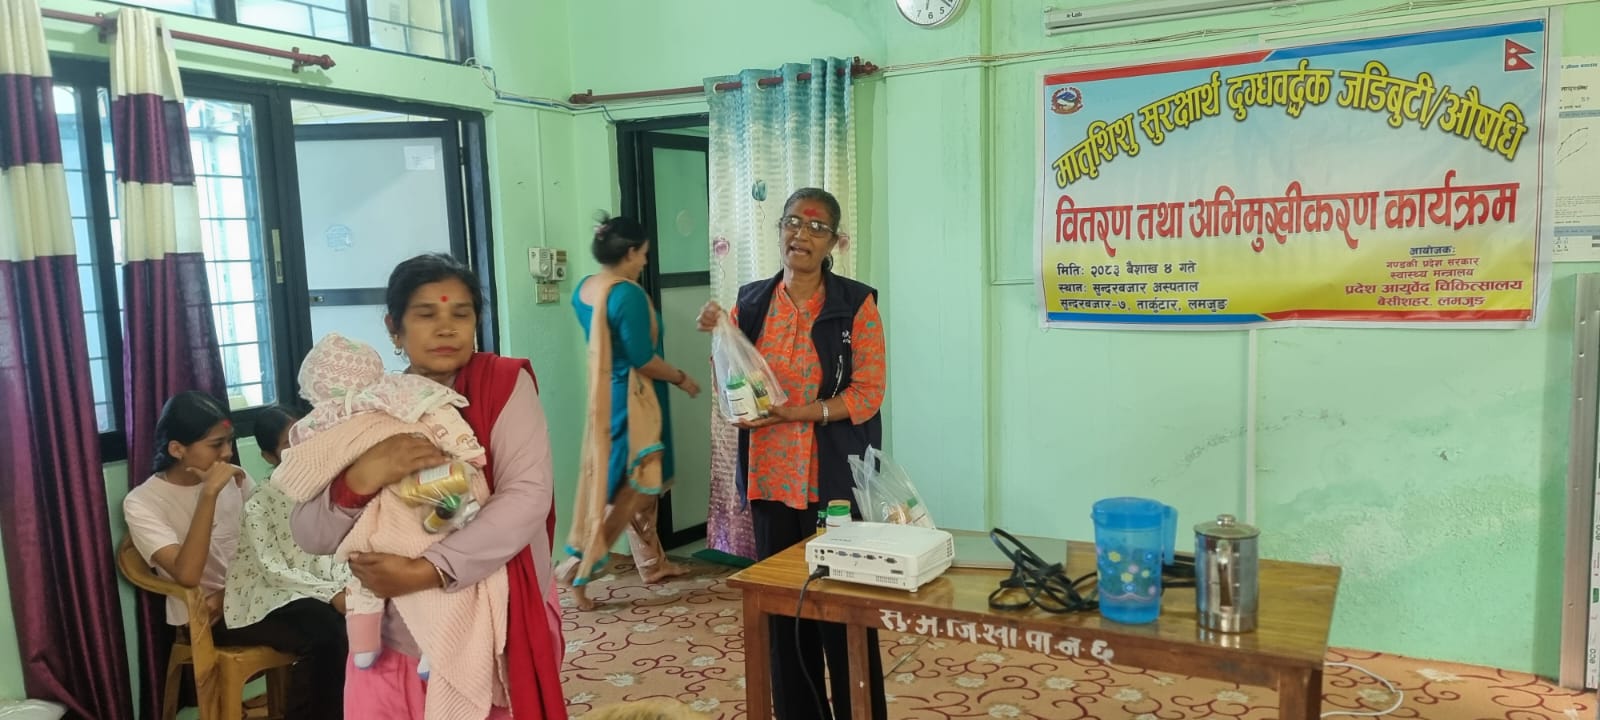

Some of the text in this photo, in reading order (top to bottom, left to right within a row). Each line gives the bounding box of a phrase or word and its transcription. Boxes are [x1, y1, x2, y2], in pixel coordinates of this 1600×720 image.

[1053, 119, 1139, 188] मातृशिशु
[1138, 71, 1221, 144] सुरक्षार्थ
[1056, 170, 1520, 257] वितरण तथा अभिमुखीकरण कार्यक्रम
[1091, 264, 1120, 278] २०८३
[1164, 263, 1173, 274] ४
[1179, 260, 1197, 273] गते
[1447, 257, 1480, 266] सरकार
[1153, 281, 1199, 293] अस्पताल
[1345, 278, 1523, 296] प्रदेश आयुर्वेद चिकित्सालय
